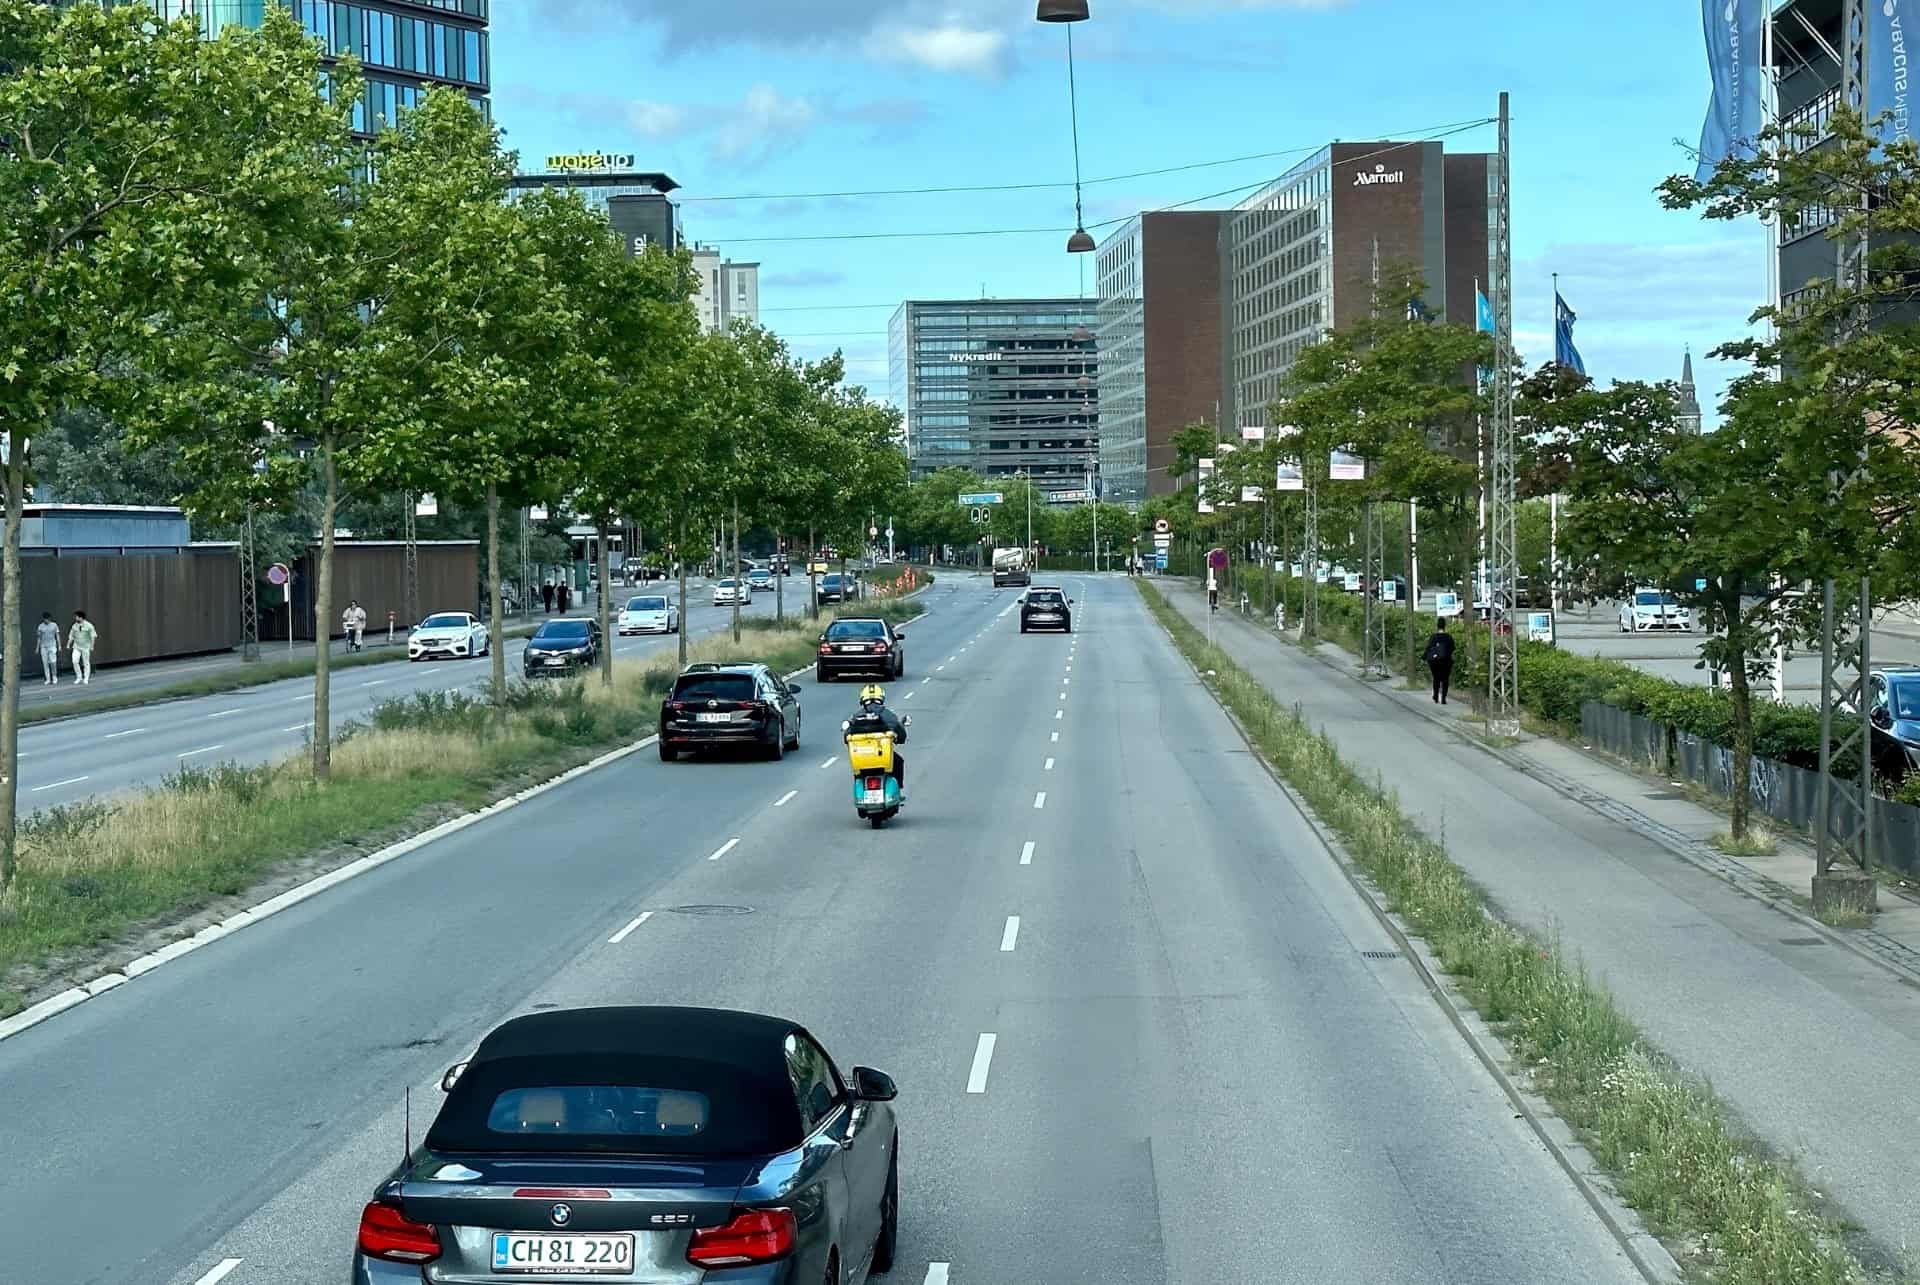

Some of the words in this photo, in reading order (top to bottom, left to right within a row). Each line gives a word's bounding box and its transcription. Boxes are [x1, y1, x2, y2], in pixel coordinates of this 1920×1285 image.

[949, 352, 1003, 363] Nykredit
[512, 1240, 543, 1263] CH
[549, 1240, 575, 1263] 81
[583, 1240, 628, 1264] 220
